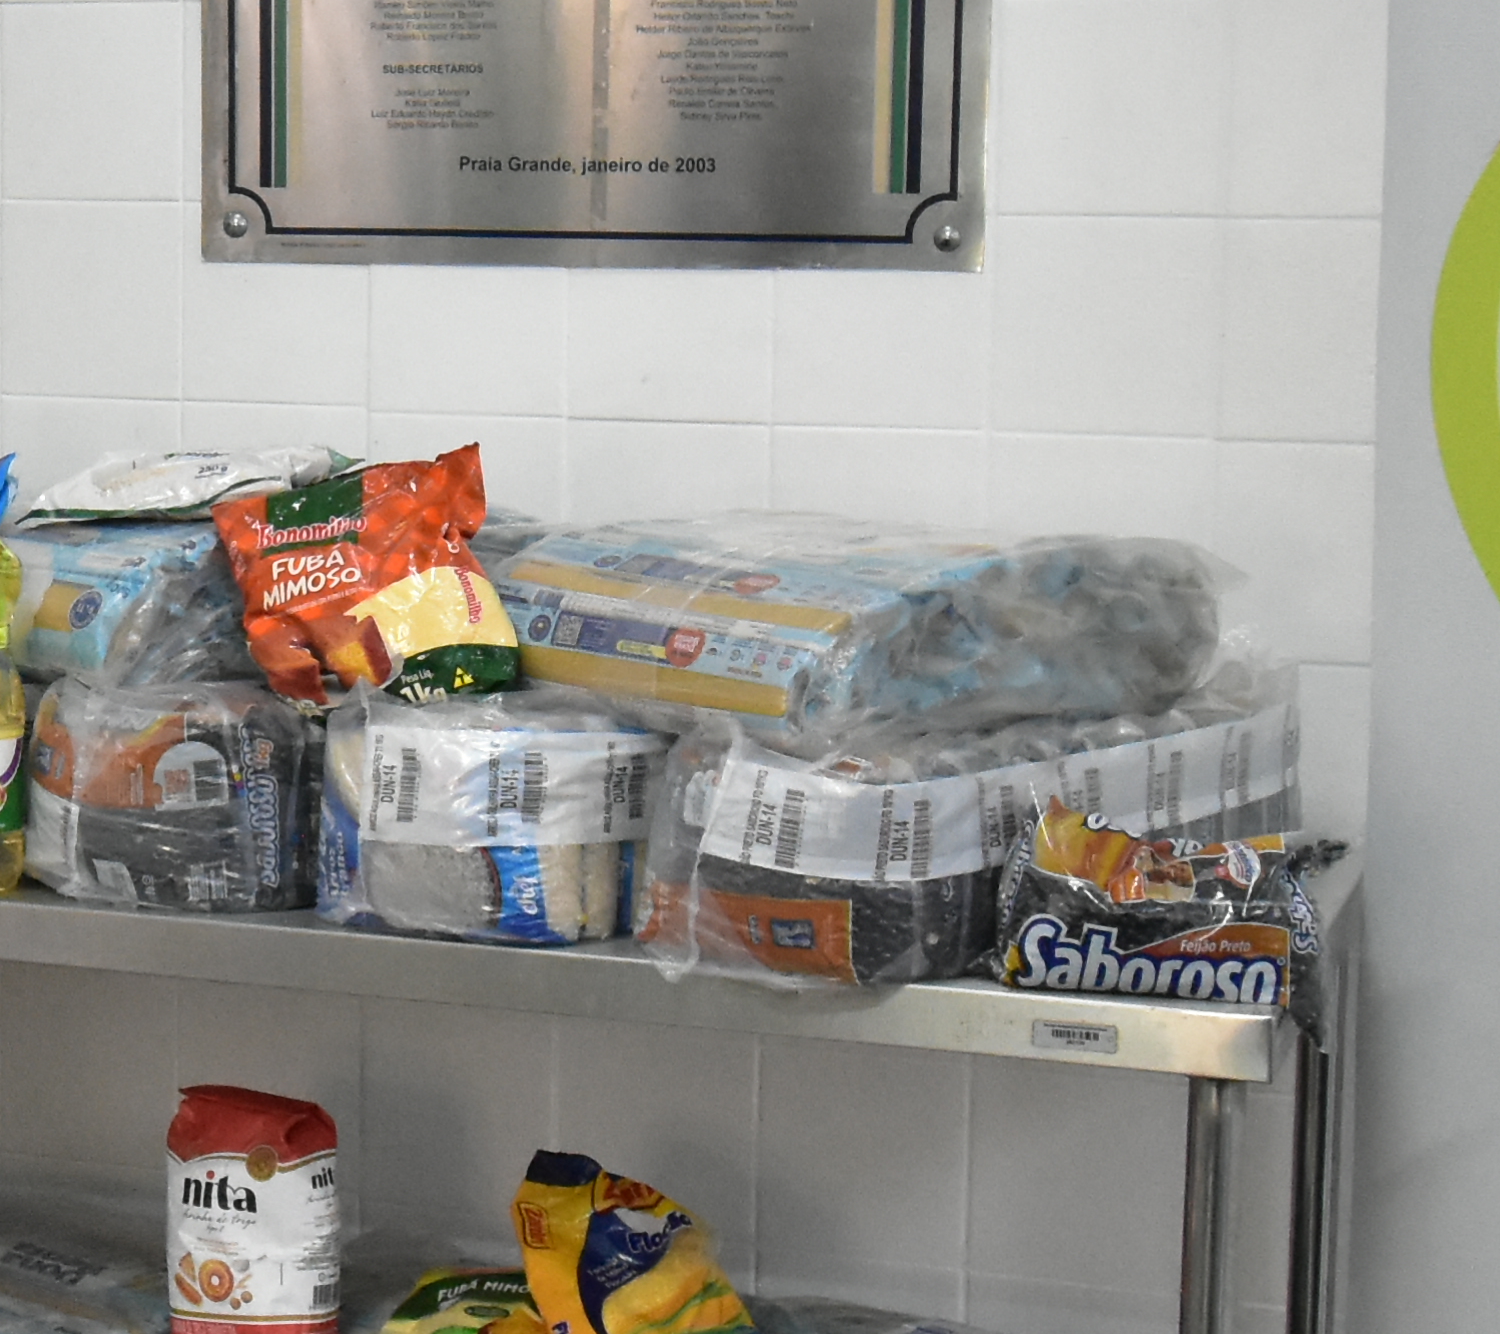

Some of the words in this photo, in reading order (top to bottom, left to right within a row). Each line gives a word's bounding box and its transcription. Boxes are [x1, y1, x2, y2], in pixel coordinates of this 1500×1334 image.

[459, 156, 503, 173] Praia
[508, 155, 577, 176] Grande,
[581, 155, 643, 176] janeiro
[648, 156, 670, 173] de
[675, 157, 717, 174] 2003
[262, 566, 361, 612] MIMOSO
[381, 763, 397, 804] DUN-14
[613, 765, 629, 804] DUN-14
[756, 803, 778, 846] DUN-14
[889, 819, 910, 862] DUN-14
[1016, 915, 1285, 1006] Saboroso
[1180, 938, 1217, 954] Feijão
[1219, 939, 1251, 953] Preto
[181, 1169, 258, 1214] nita
[310, 1166, 335, 1190] nit
[483, 1280, 531, 1295] MIMO
